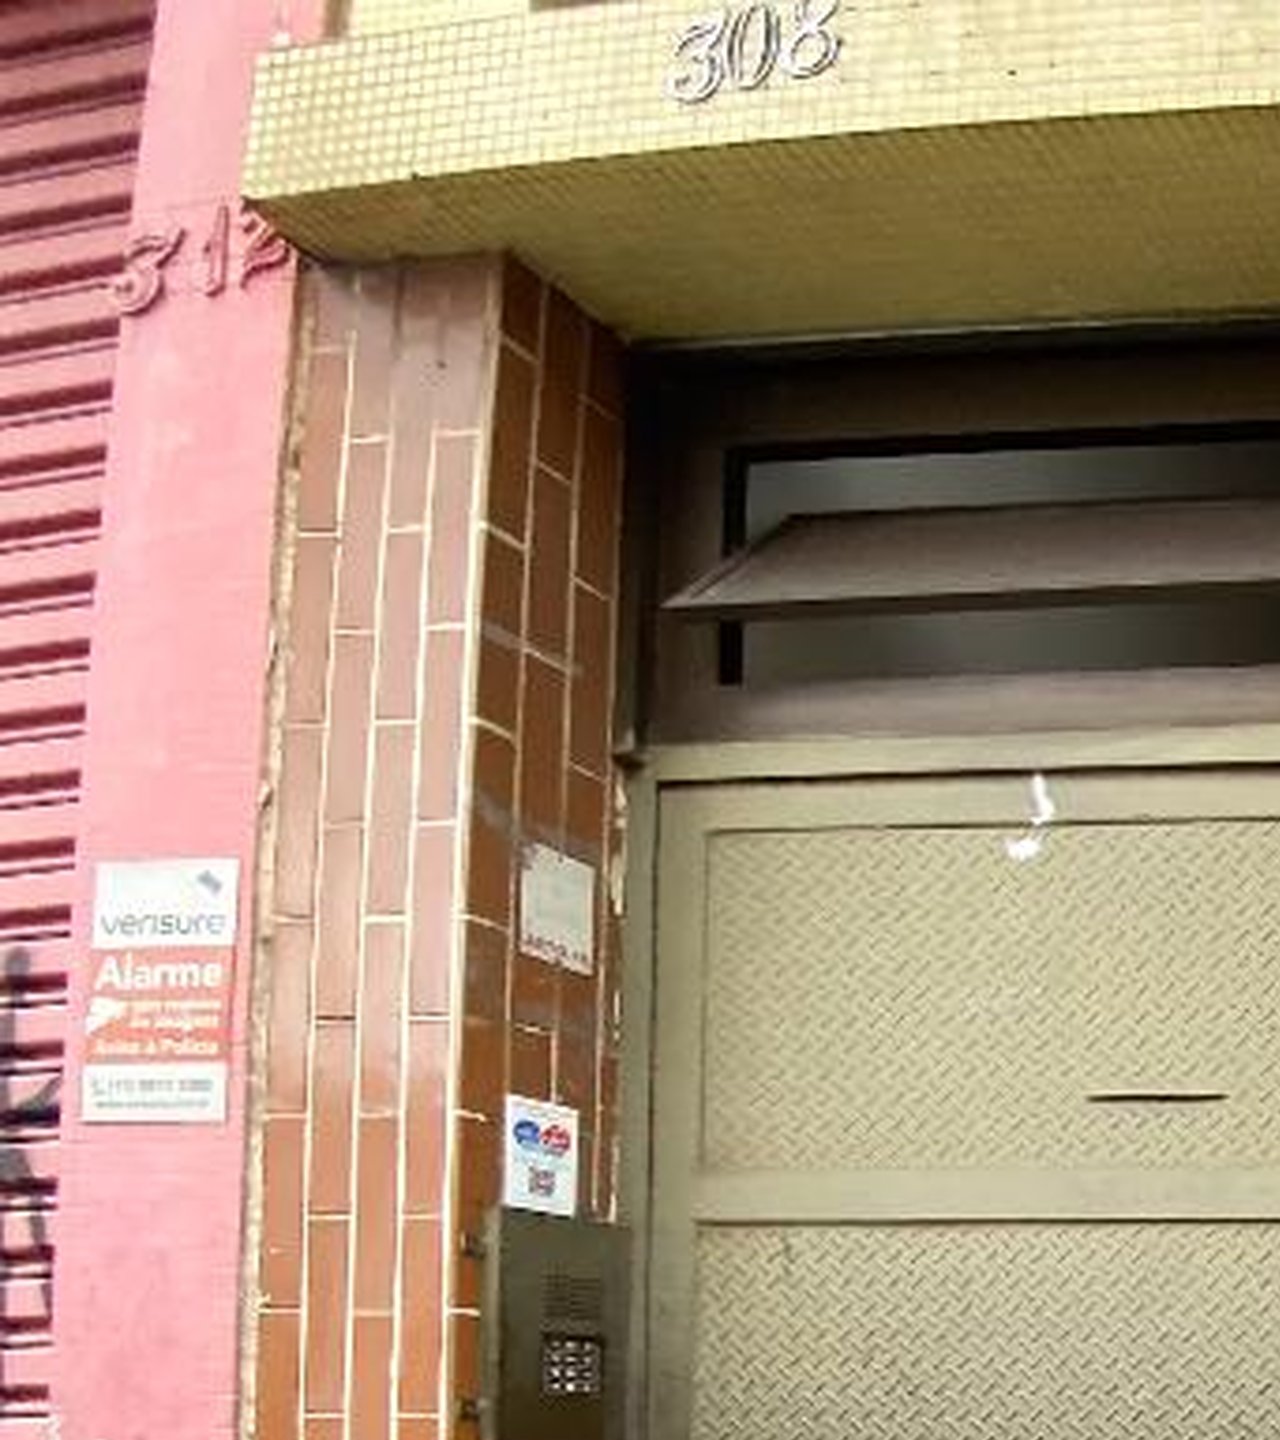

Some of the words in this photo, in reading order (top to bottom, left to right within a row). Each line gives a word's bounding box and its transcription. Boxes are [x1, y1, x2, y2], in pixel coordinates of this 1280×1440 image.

[664, 0, 843, 104] 308
[100, 914, 226, 936] verisure
[94, 952, 223, 991] Alarme
